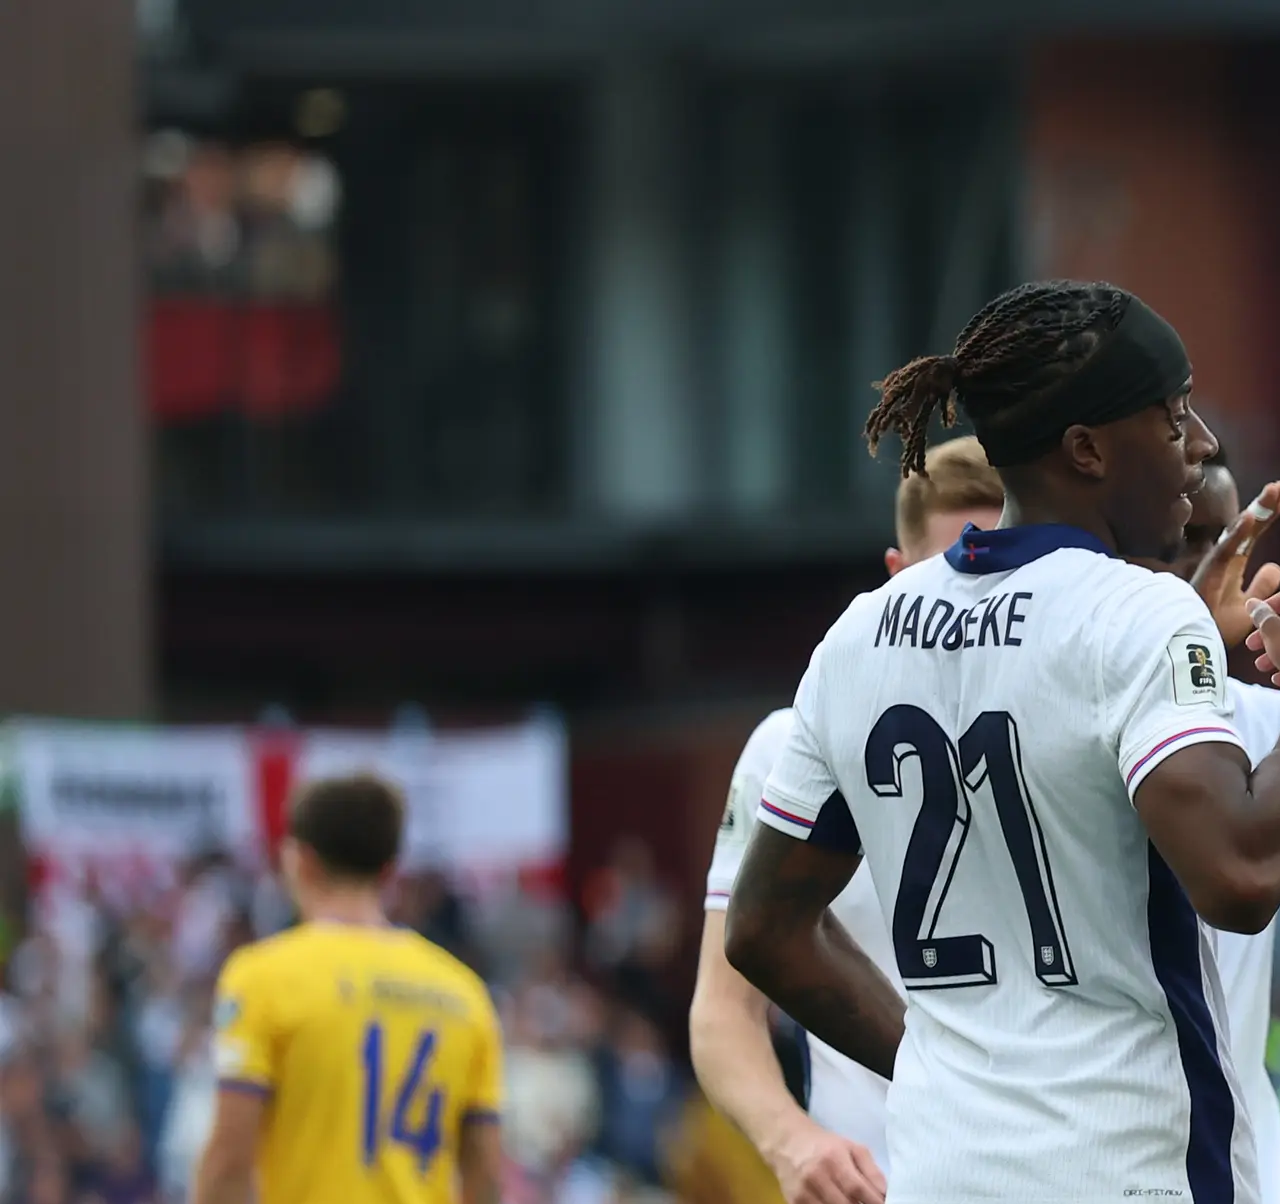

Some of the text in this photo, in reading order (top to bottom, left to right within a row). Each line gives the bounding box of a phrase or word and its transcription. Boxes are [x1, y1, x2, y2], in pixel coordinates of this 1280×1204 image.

[1200, 677, 1213, 685] FIFA
[865, 704, 1079, 990] 21
[362, 1020, 443, 1172] 14
